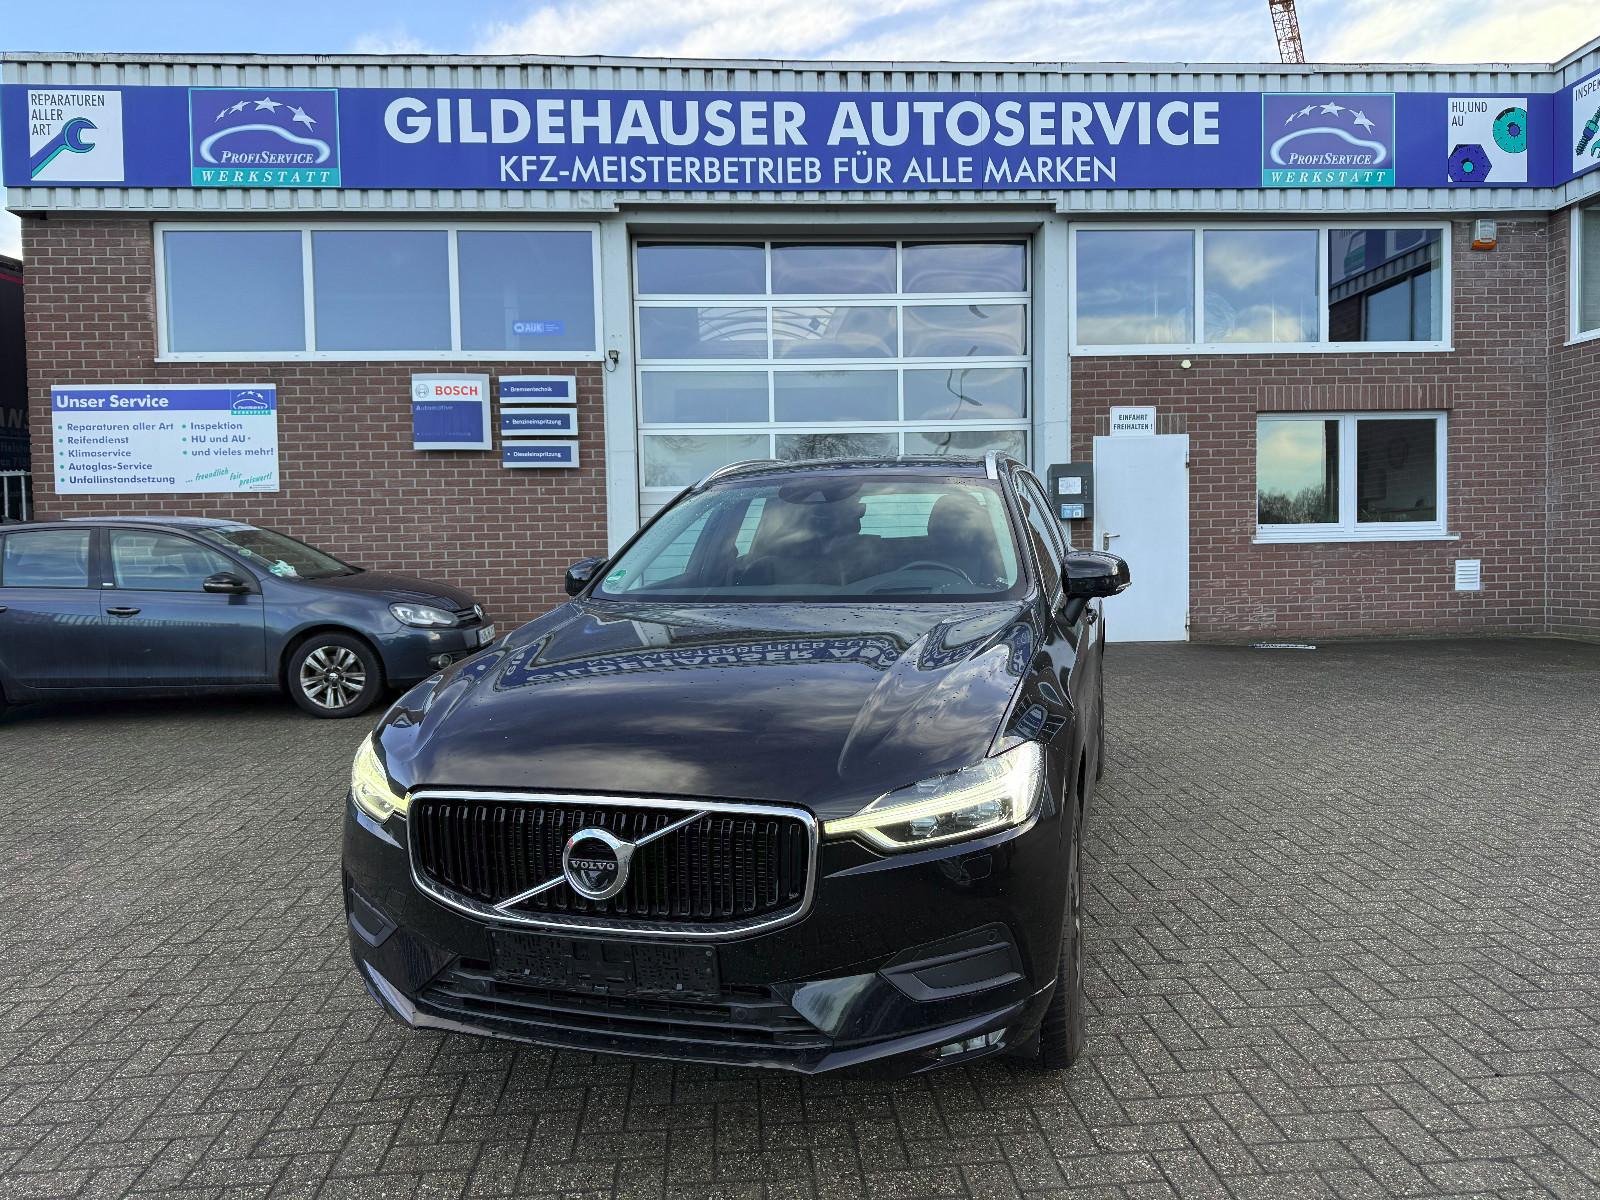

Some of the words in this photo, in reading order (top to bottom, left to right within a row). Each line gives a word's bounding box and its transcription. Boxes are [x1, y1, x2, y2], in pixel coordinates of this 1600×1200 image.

[31, 93, 105, 107] REPARATUREN
[1468, 101, 1488, 112] UND
[31, 109, 63, 121] ALLER
[1452, 115, 1464, 126] AU
[384, 97, 807, 146] GILDEHAUSER
[827, 100, 1219, 146] AUTOSERVICE
[32, 124, 51, 136] ART
[500, 155, 821, 183] KFZ-MEISTERBETRIEB
[834, 150, 893, 183] FÜR
[903, 156, 972, 183] ALLE
[984, 156, 1116, 183] MARKEN
[202, 170, 330, 183] WERKSTATT
[1272, 171, 1387, 183] WERKSTATT
[435, 386, 478, 396] BOSCH
[56, 395, 106, 409] Unser
[109, 394, 169, 408] Service
[67, 423, 130, 432] Reparaturen
[132, 422, 156, 431] aller
[158, 422, 174, 430] Art
[190, 422, 243, 432] Inspektion
[67, 436, 129, 445] Reifendienst
[191, 435, 207, 443] HU
[209, 435, 229, 443] und
[68, 449, 132, 458] Klimaservice
[191, 448, 212, 456] und
[214, 448, 242, 456] vieles
[244, 447, 274, 456] mehr!
[68, 462, 153, 472] Autoglas-Service
[195, 467, 229, 481] freundlich
[69, 475, 176, 485] Unfallinstandsetzung
[569, 860, 615, 870] VOLVO
